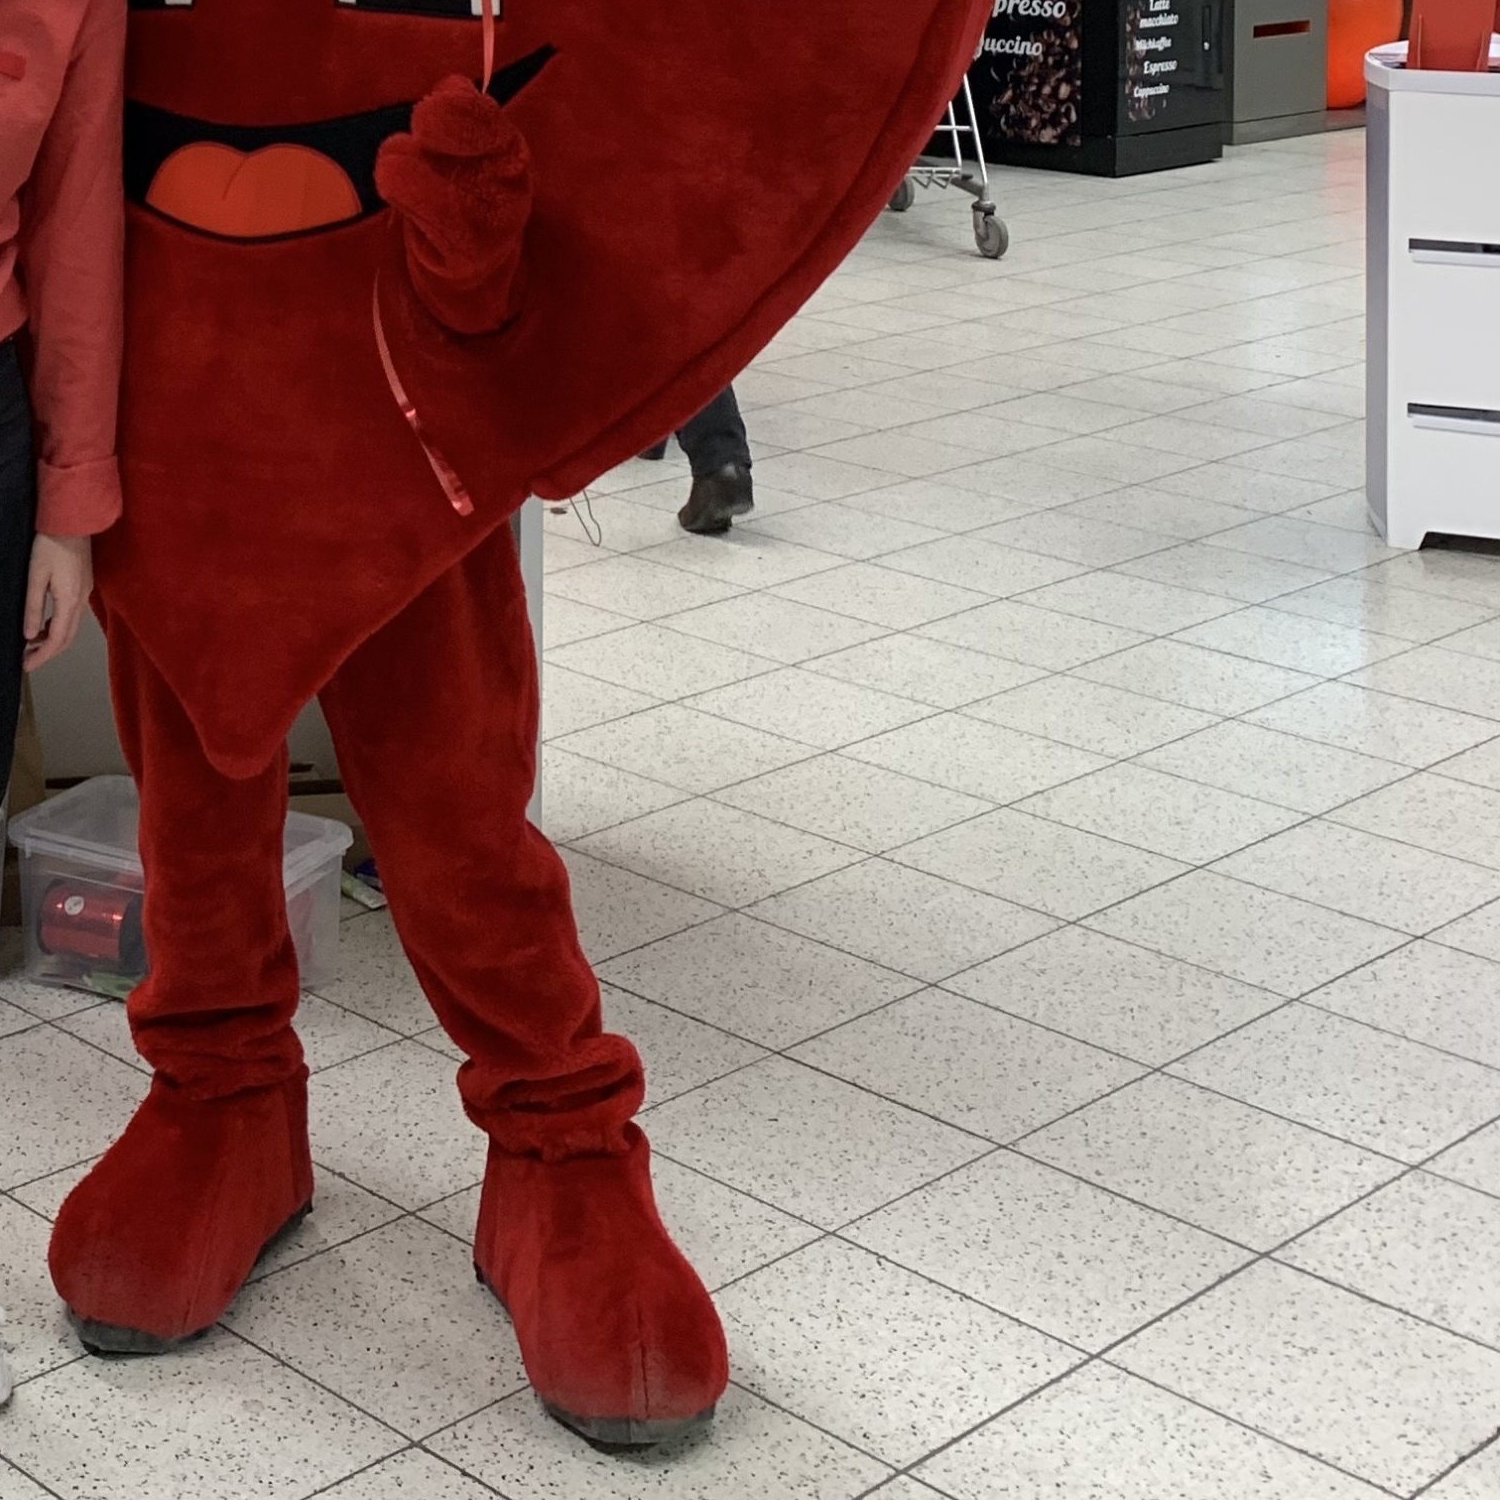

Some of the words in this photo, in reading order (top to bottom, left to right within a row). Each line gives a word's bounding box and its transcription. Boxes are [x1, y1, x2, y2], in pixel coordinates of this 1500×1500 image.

[1139, 13, 1179, 29] macchiato
[1143, 60, 1178, 75] Espresso
[1134, 83, 1170, 98] Cappuccino
